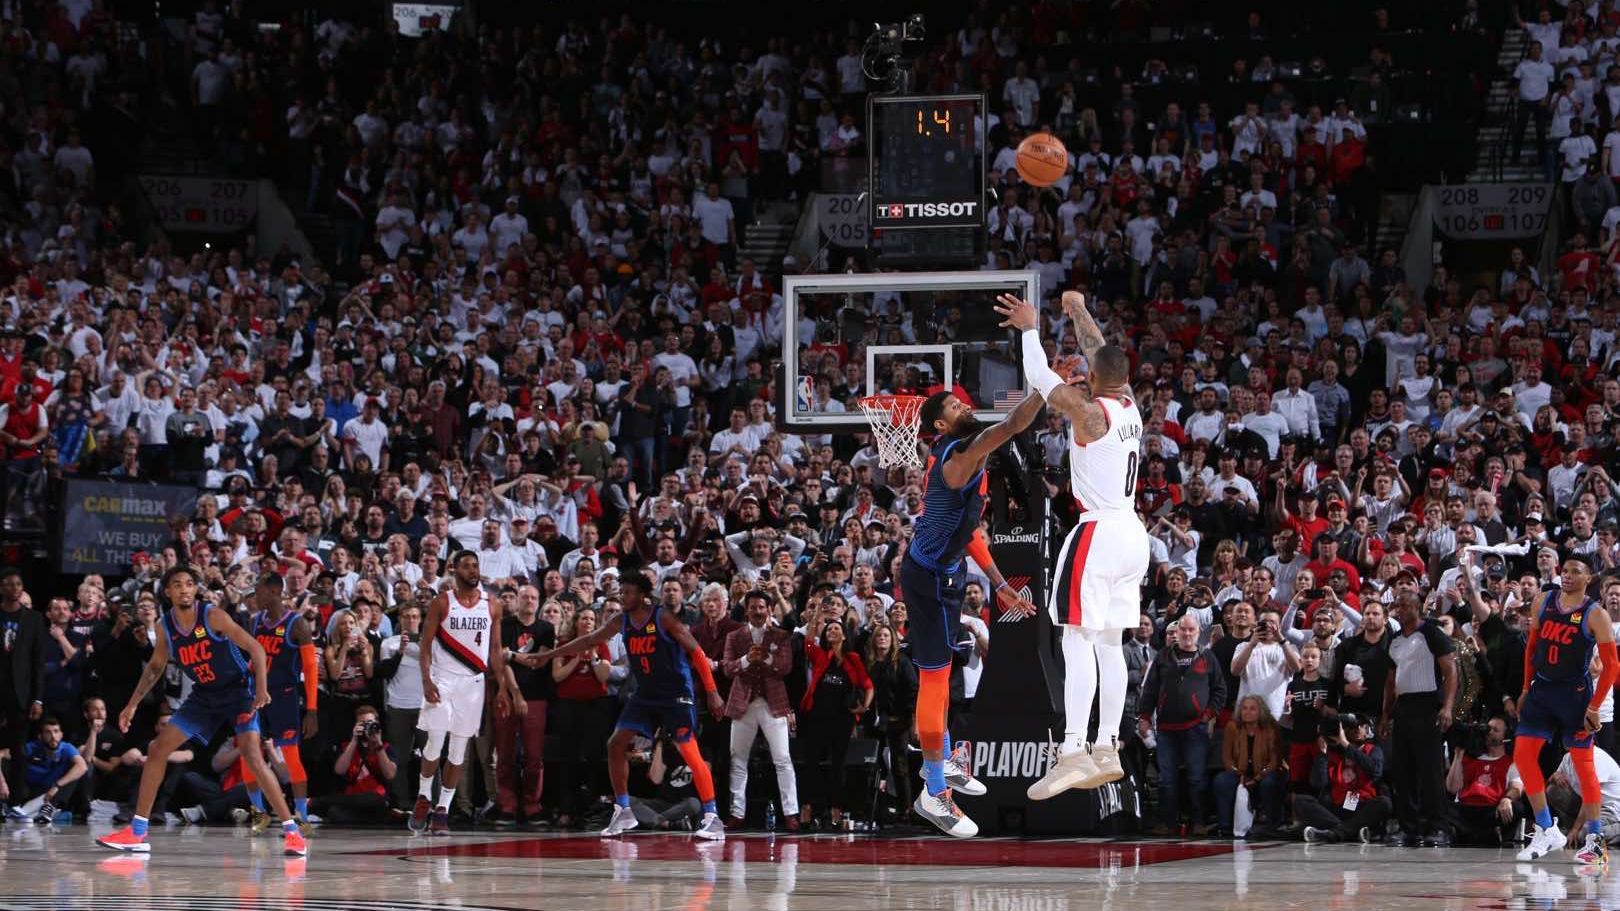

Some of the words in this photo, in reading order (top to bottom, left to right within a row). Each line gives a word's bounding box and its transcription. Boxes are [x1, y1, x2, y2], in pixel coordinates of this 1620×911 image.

[918, 109, 950, 136] 1.4
[211, 183, 247, 200] 207
[1441, 188, 1480, 207] 208
[1508, 187, 1547, 206] 209
[904, 202, 977, 218] TISSOT
[1443, 214, 1480, 231] 106
[1510, 213, 1546, 230] 107
[829, 223, 865, 240] 105
[1124, 450, 1137, 498] 0
[98, 530, 126, 546] WE
[129, 532, 163, 548] BUY
[993, 532, 1039, 545] SPALDING
[72, 547, 97, 564] ALL
[450, 615, 489, 631] BLAZERS
[474, 631, 484, 648] 4
[1540, 619, 1578, 646] OKC
[178, 638, 213, 667] OKC
[629, 635, 657, 655] OKC
[1548, 643, 1559, 666] 0
[640, 656, 650, 675] 9
[1294, 689, 1329, 702] ELITE
